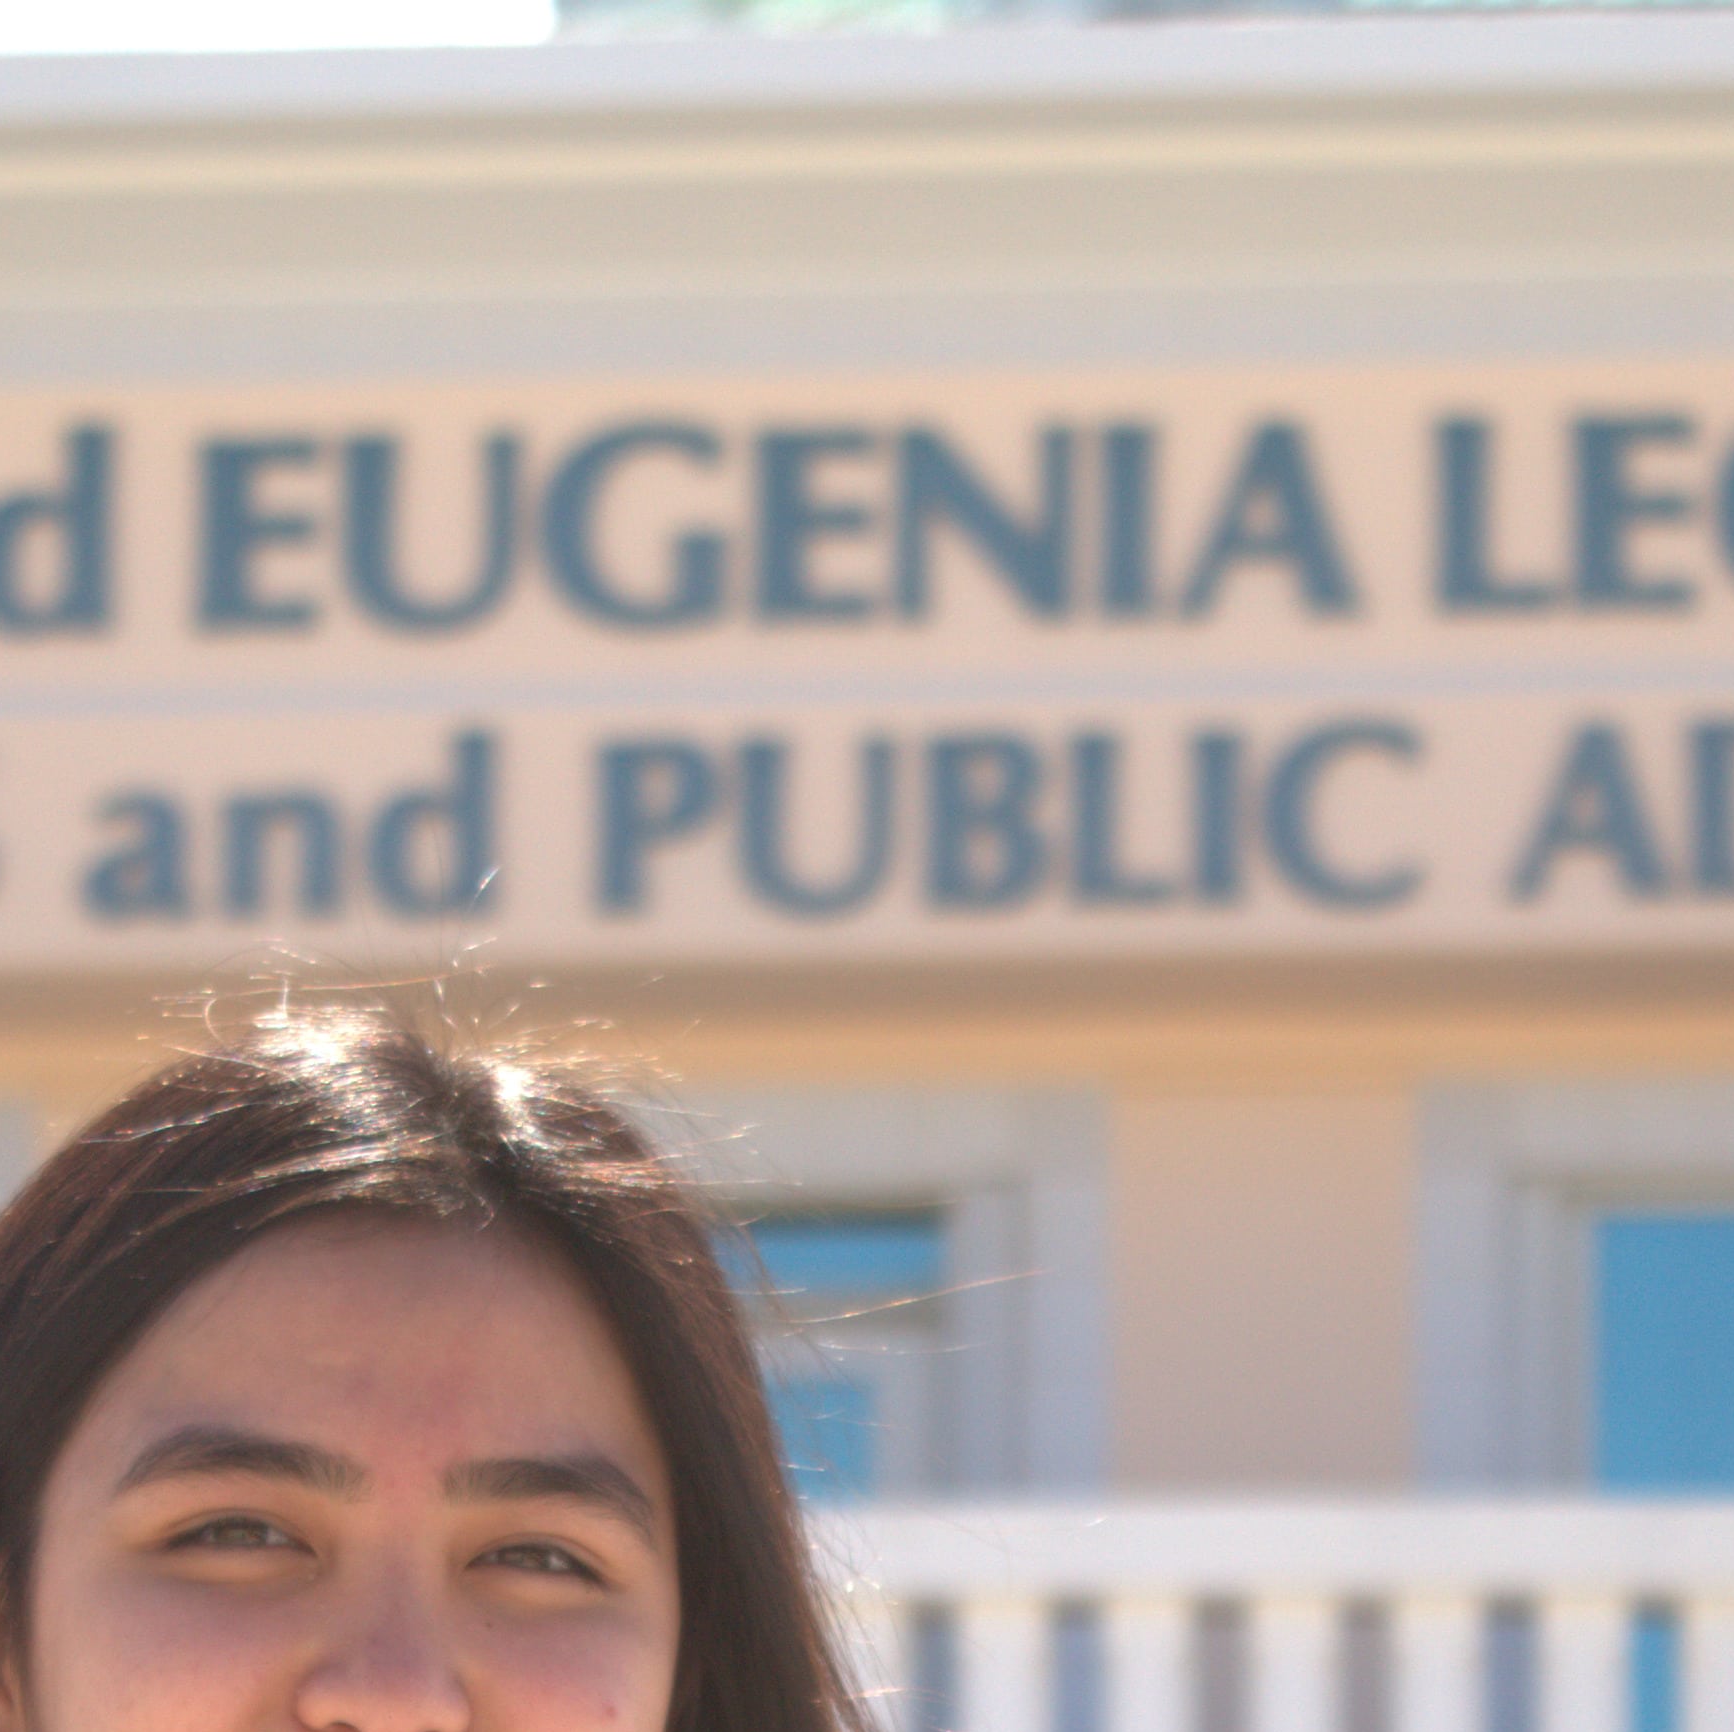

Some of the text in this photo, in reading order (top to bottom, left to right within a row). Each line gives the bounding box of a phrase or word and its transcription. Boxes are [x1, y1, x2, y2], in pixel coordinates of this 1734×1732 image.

[196, 418, 1356, 634] EUGENIA
[83, 728, 495, 920] and
[596, 720, 1414, 916] PUBLIC
